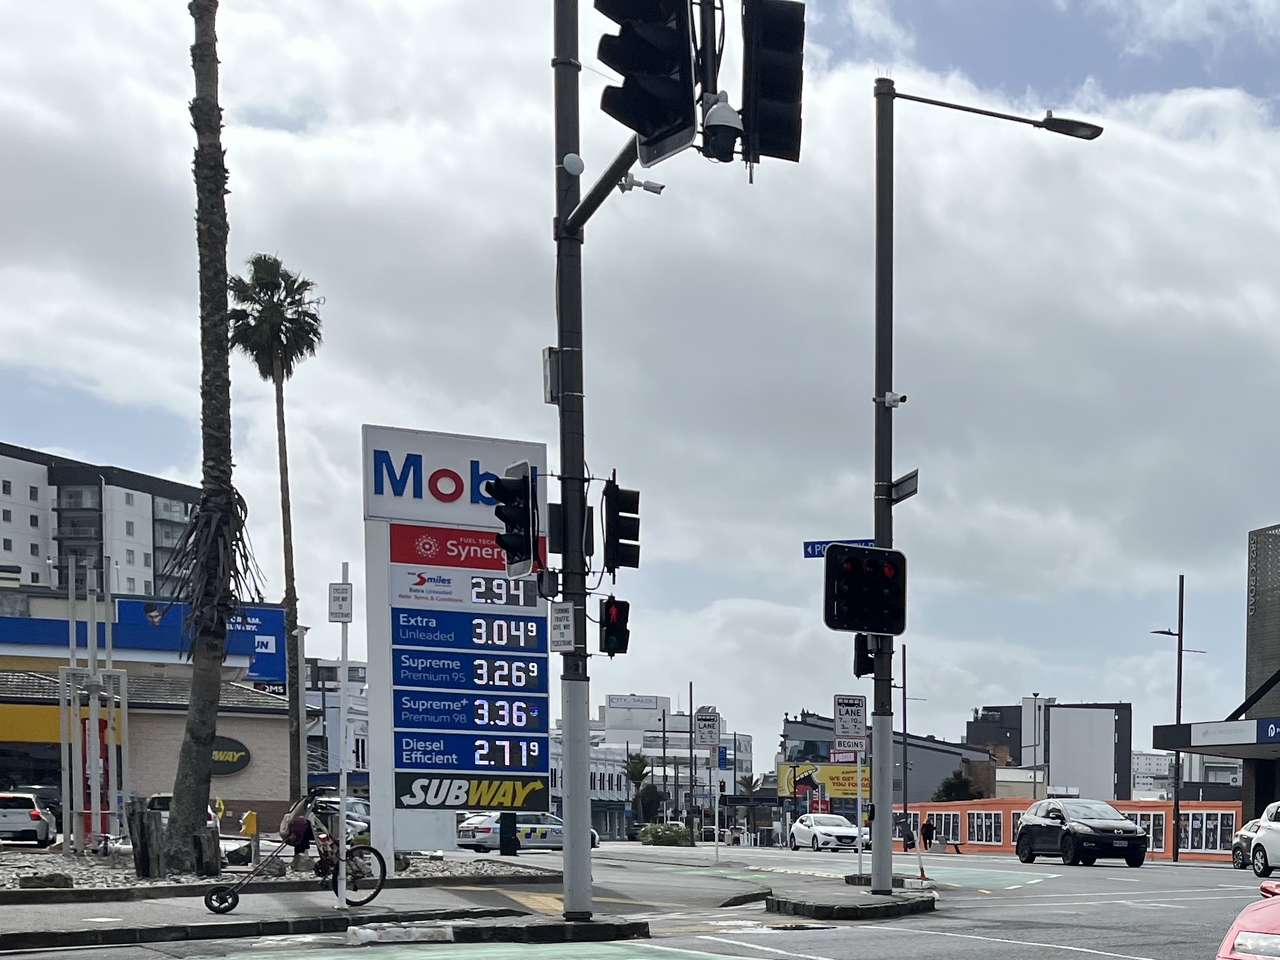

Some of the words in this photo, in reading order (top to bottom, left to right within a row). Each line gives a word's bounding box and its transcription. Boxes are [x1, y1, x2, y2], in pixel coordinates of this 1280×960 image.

[373, 449, 538, 506] Mobl
[411, 571, 452, 587] Smiles
[399, 614, 436, 628] Extra
[399, 628, 455, 641] Unleaded
[401, 655, 461, 670] Supreme
[401, 670, 450, 682] Premium
[452, 673, 466, 683] 95
[401, 712, 450, 723] Premium
[452, 714, 467, 724] 98
[838, 709, 862, 717] LANE
[402, 738, 444, 751] Diesel
[837, 741, 864, 749] BEGINS
[402, 752, 458, 765] Efficient
[400, 778, 544, 807] SUBWAY
